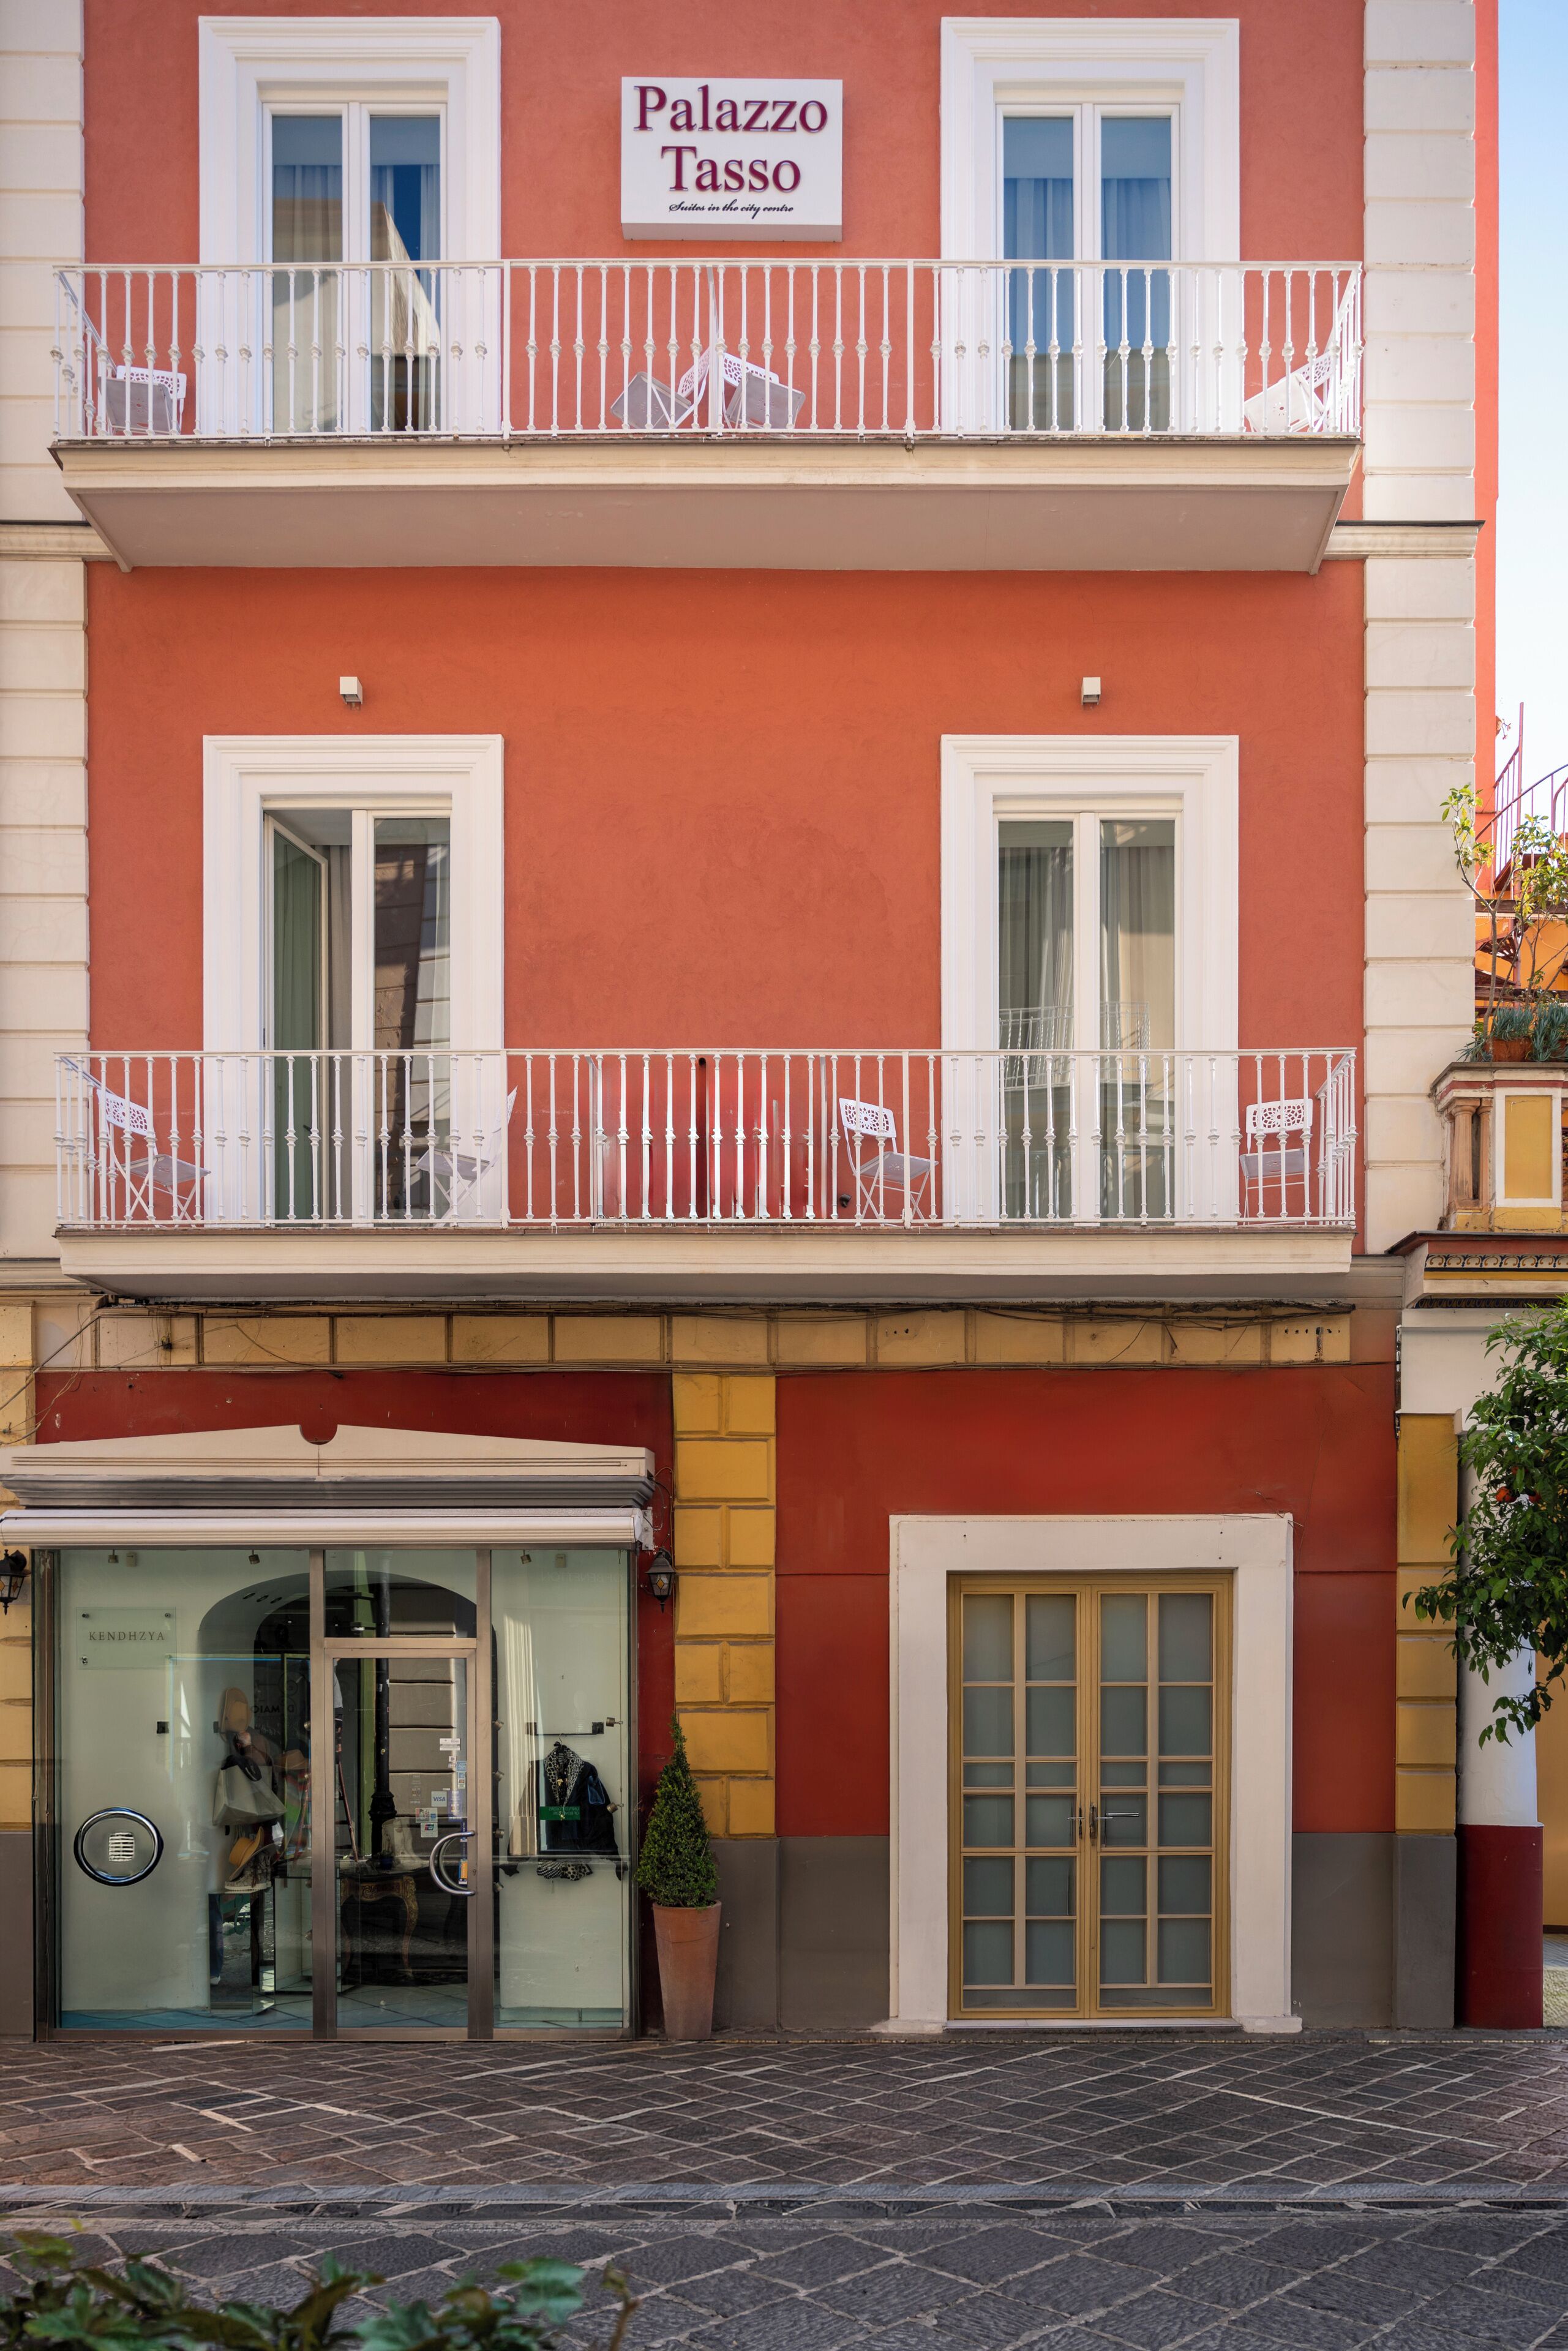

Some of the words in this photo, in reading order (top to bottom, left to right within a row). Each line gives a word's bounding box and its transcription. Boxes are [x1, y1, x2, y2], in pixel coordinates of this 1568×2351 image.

[633, 84, 828, 133] Palazzo
[661, 146, 801, 192] Tasso
[669, 201, 705, 212] Suites
[722, 198, 738, 212] the
[740, 203, 761, 219] city
[88, 1631, 165, 1641] KENDHZYA
